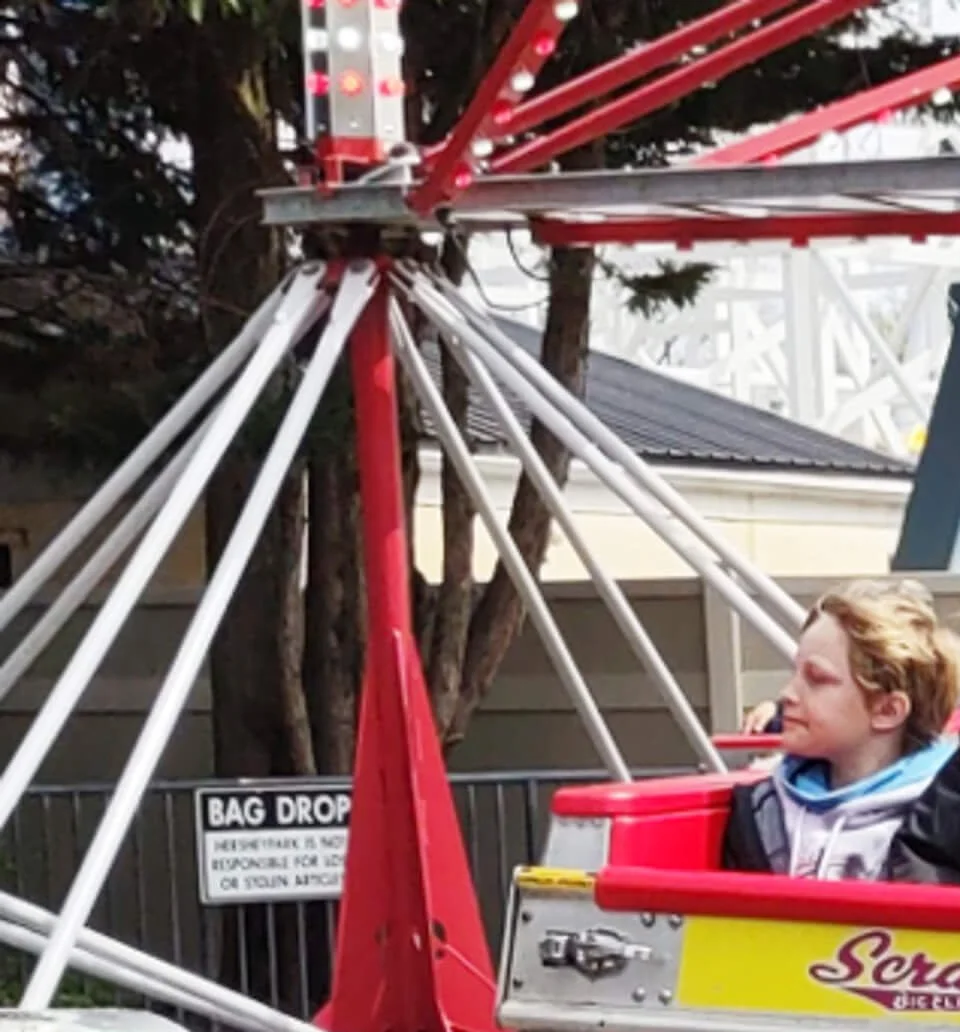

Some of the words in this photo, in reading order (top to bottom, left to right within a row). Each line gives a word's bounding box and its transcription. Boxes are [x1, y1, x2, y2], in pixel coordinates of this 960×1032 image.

[208, 796, 266, 827] BAG
[276, 793, 351, 825] DROP
[294, 853, 318, 868] FOR
[220, 876, 239, 891] OR
